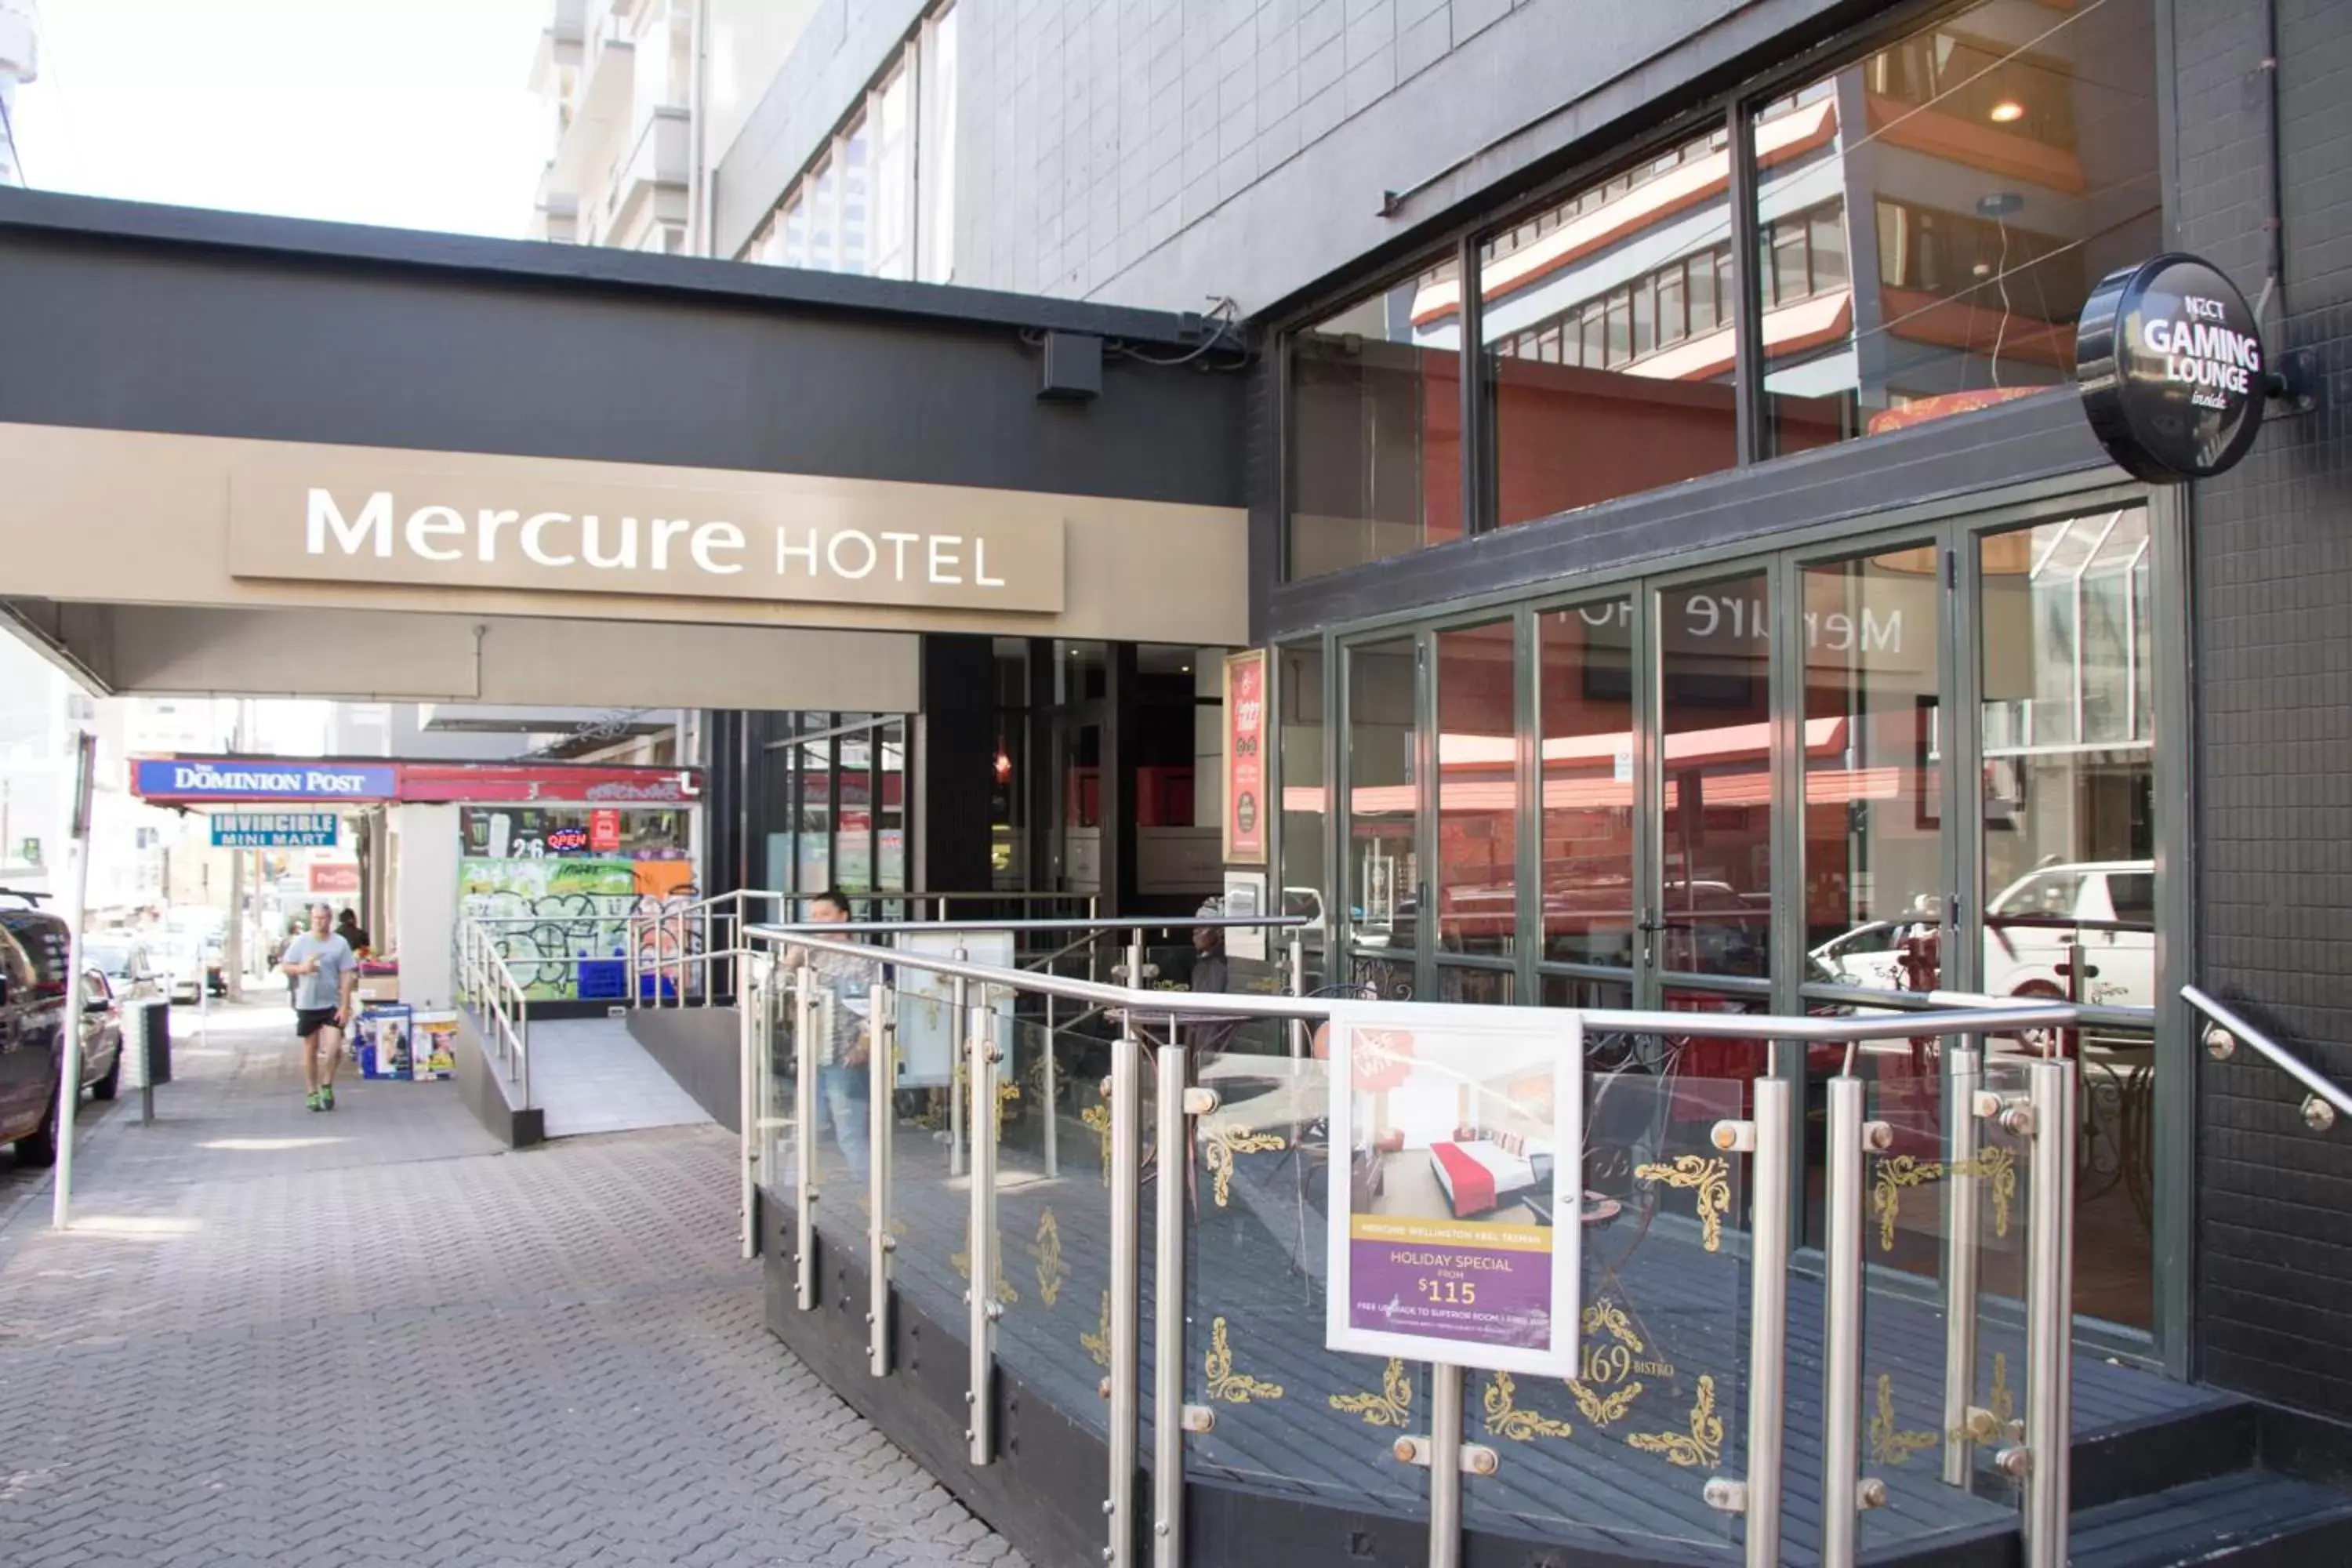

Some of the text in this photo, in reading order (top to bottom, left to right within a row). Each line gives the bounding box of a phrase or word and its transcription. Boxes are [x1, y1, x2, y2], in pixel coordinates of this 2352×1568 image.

[2184, 295, 2226, 320] NZCT
[2143, 318, 2259, 372] GAMING
[2166, 355, 2249, 394] LOUNGE
[305, 488, 1007, 587] Mercure HOTEL
[214, 814, 333, 832] INVINCIBLE
[222, 833, 326, 845] MINI MART
[547, 833, 586, 849] OPEN
[1391, 1250, 1513, 1272] HOLIDAY SPECIAL
[1438, 1269, 1465, 1279] FROM
[1417, 1278, 1476, 1305] $115
[1581, 1343, 1632, 1383] 169
